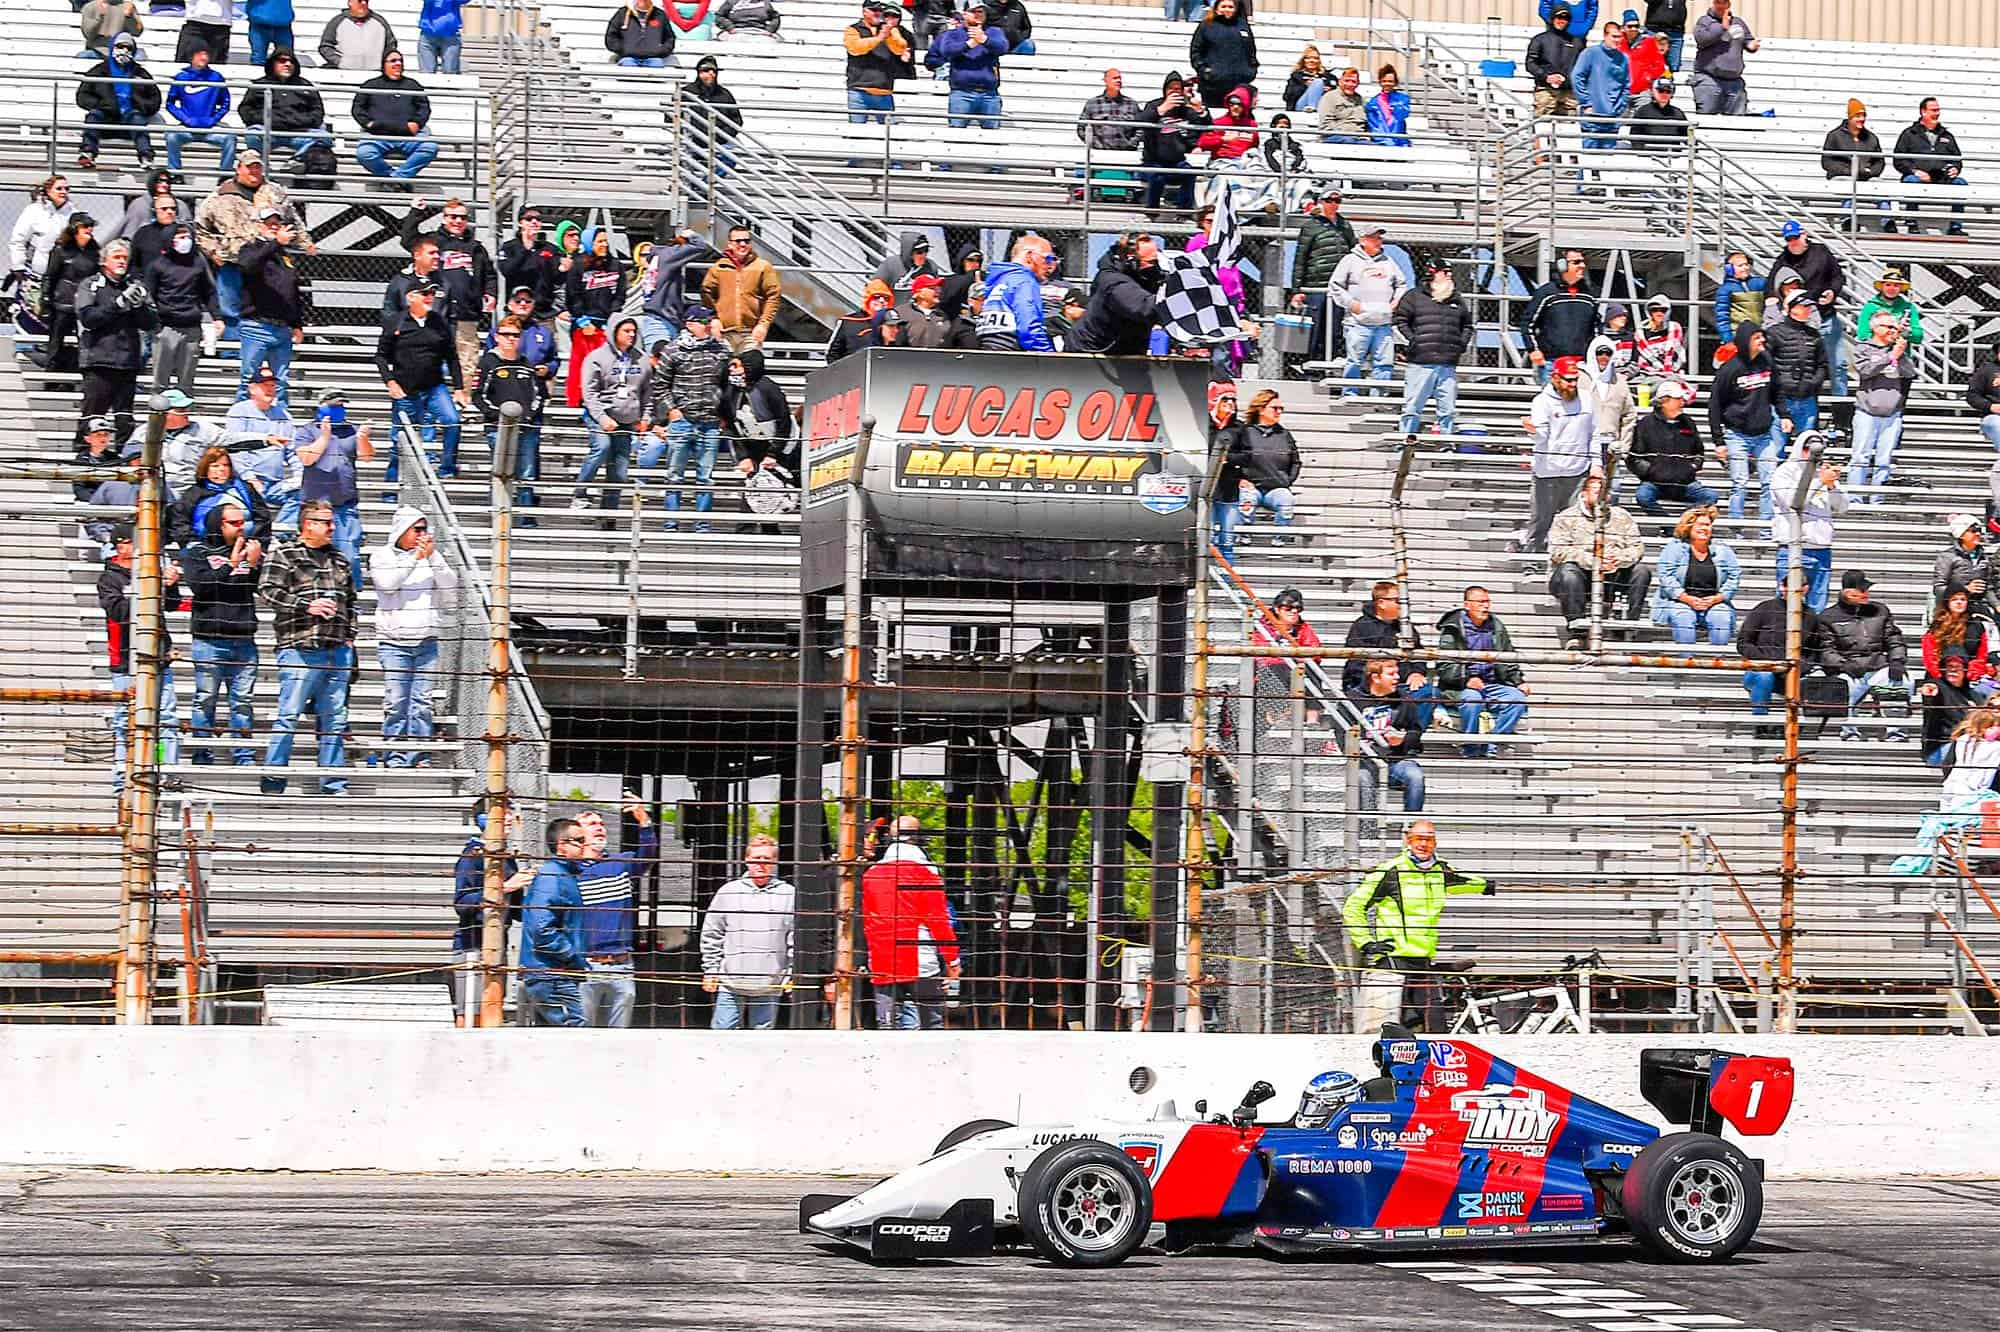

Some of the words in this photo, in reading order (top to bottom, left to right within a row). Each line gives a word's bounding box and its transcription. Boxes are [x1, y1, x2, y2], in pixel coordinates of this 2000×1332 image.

[897, 384, 1073, 441] LUCAS
[1076, 390, 1160, 442] OIL
[904, 449, 1148, 482] RACEWAY
[900, 478, 1134, 495] INDIANAPOLIS
[1745, 1081, 1765, 1119] 1
[1470, 1107, 1559, 1141] INDY
[1371, 1128, 1397, 1143] one
[1399, 1131, 1427, 1142] cure
[1603, 1144, 1645, 1158] COOP
[1289, 1160, 1335, 1173] REMA
[1338, 1160, 1372, 1173] 1000
[1485, 1192, 1525, 1204] DANSK
[1485, 1204, 1525, 1217] METAL
[879, 1224, 952, 1235] COOPER
[912, 1234, 950, 1242] TIRES
